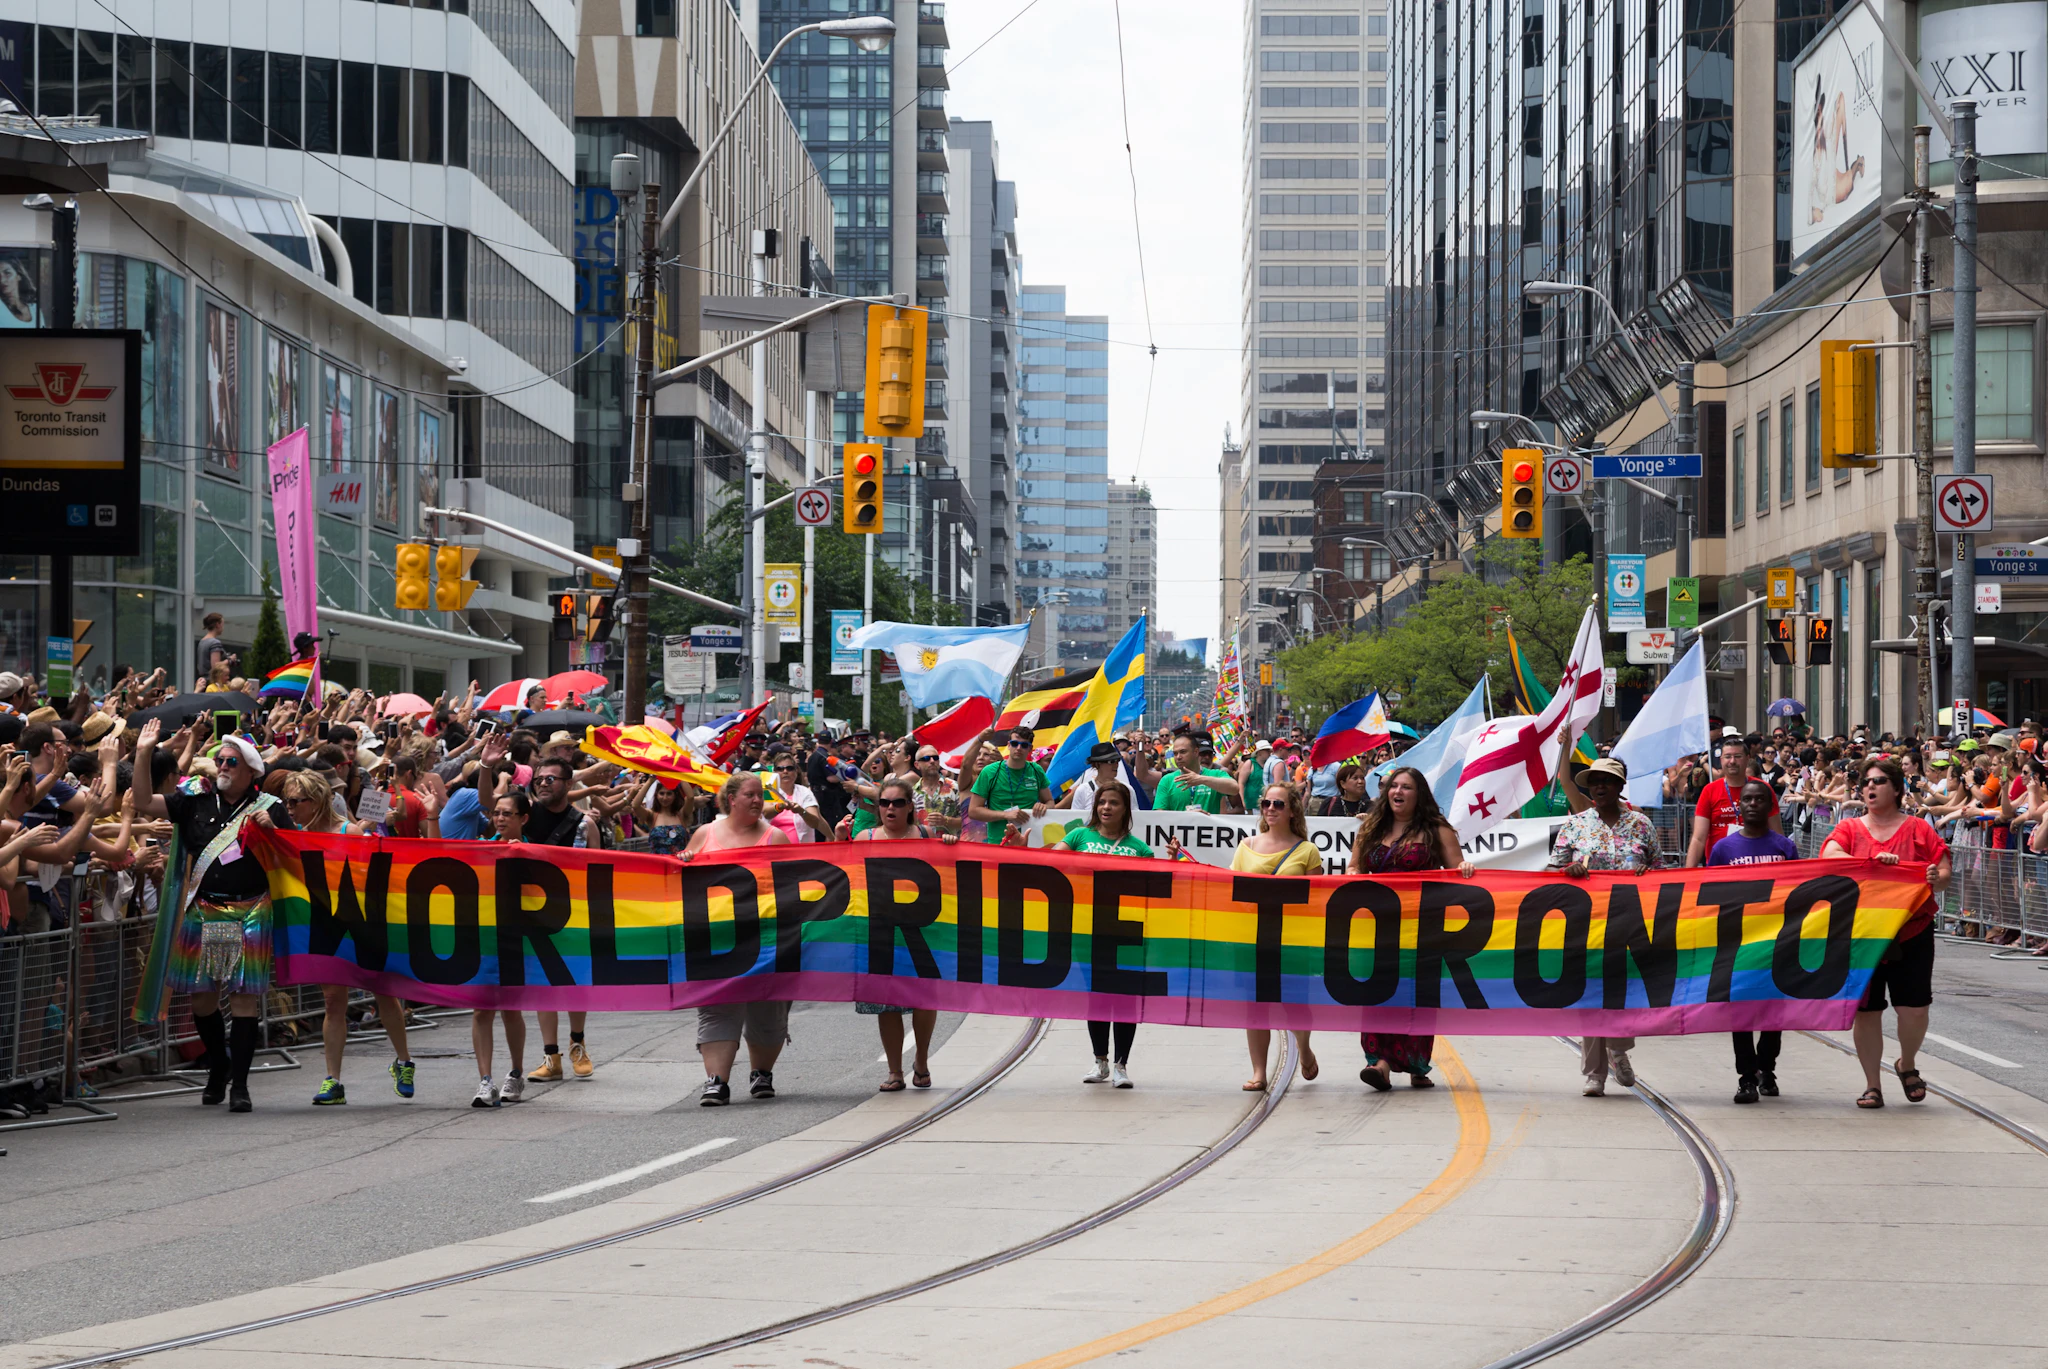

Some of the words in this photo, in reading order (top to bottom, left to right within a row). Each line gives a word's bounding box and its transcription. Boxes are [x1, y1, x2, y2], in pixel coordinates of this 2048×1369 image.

[1853, 41, 1874, 104] XXI
[1930, 50, 2027, 100] XXI
[1928, 97, 2028, 115] OVER
[14, 410, 62, 422] Toronto
[64, 411, 107, 423] Transit
[21, 424, 99, 437] Commission
[1618, 457, 1665, 476] Yonge
[1667, 457, 1677, 466] St
[2, 478, 60, 491] Dundas
[273, 464, 299, 493] Pride
[329, 482, 362, 504] H&M
[1990, 560, 2026, 573] Yonge
[2028, 562, 2038, 572] St
[1984, 586, 1992, 594] NO
[1977, 596, 1999, 604] STANDING
[700, 637, 725, 646] Yonge
[668, 650, 689, 658] JESUS
[1643, 650, 1670, 659] Subwa
[362, 795, 382, 804] united
[1231, 874, 1861, 1010] TORONTO
